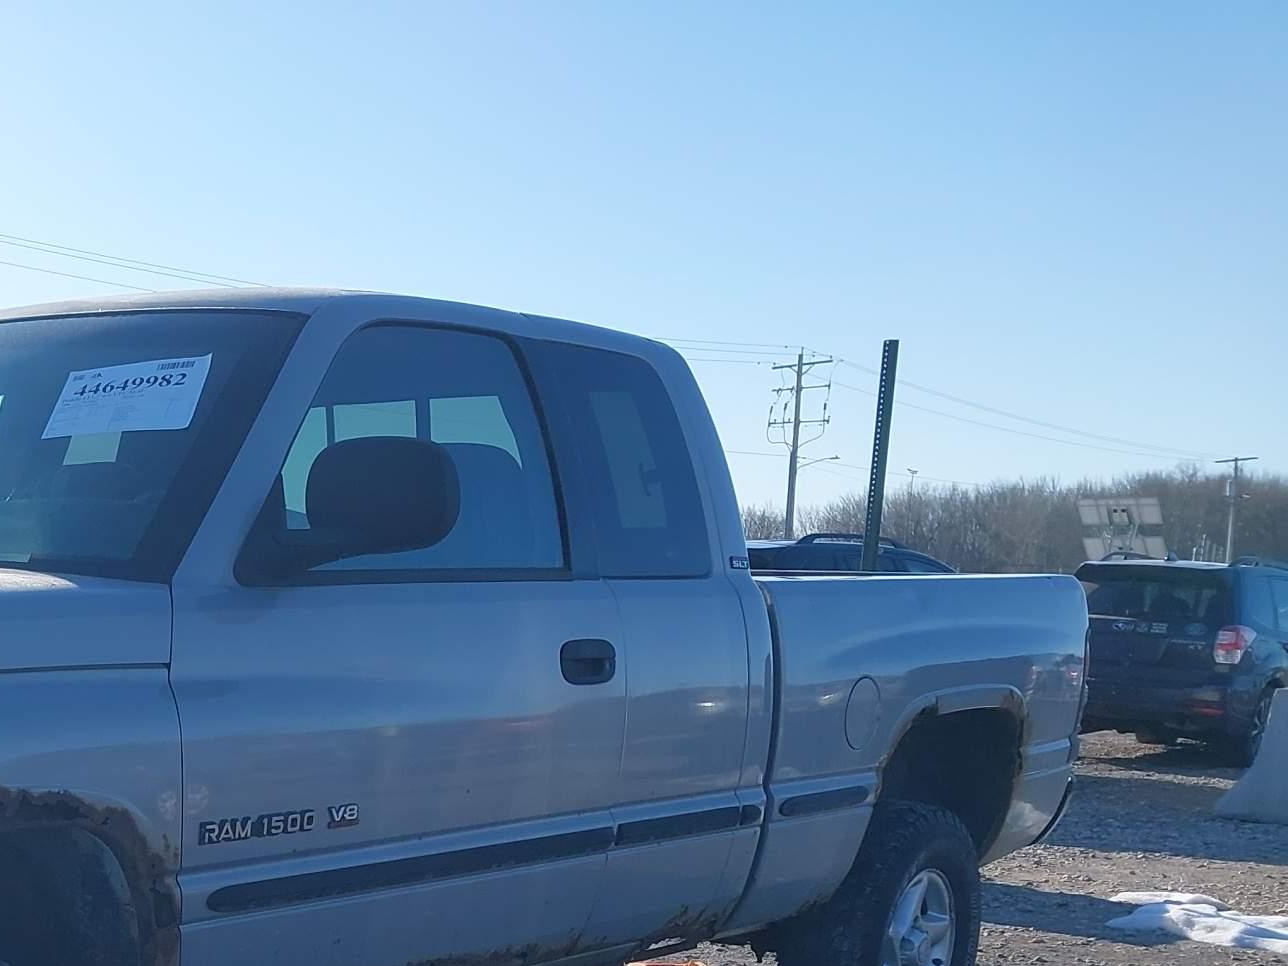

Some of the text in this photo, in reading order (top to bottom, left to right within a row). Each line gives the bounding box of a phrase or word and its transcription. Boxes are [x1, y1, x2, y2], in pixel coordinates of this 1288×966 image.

[73, 372, 189, 397] 44649982
[731, 559, 748, 568] SLT
[203, 803, 360, 845] RAM 1500 V8
